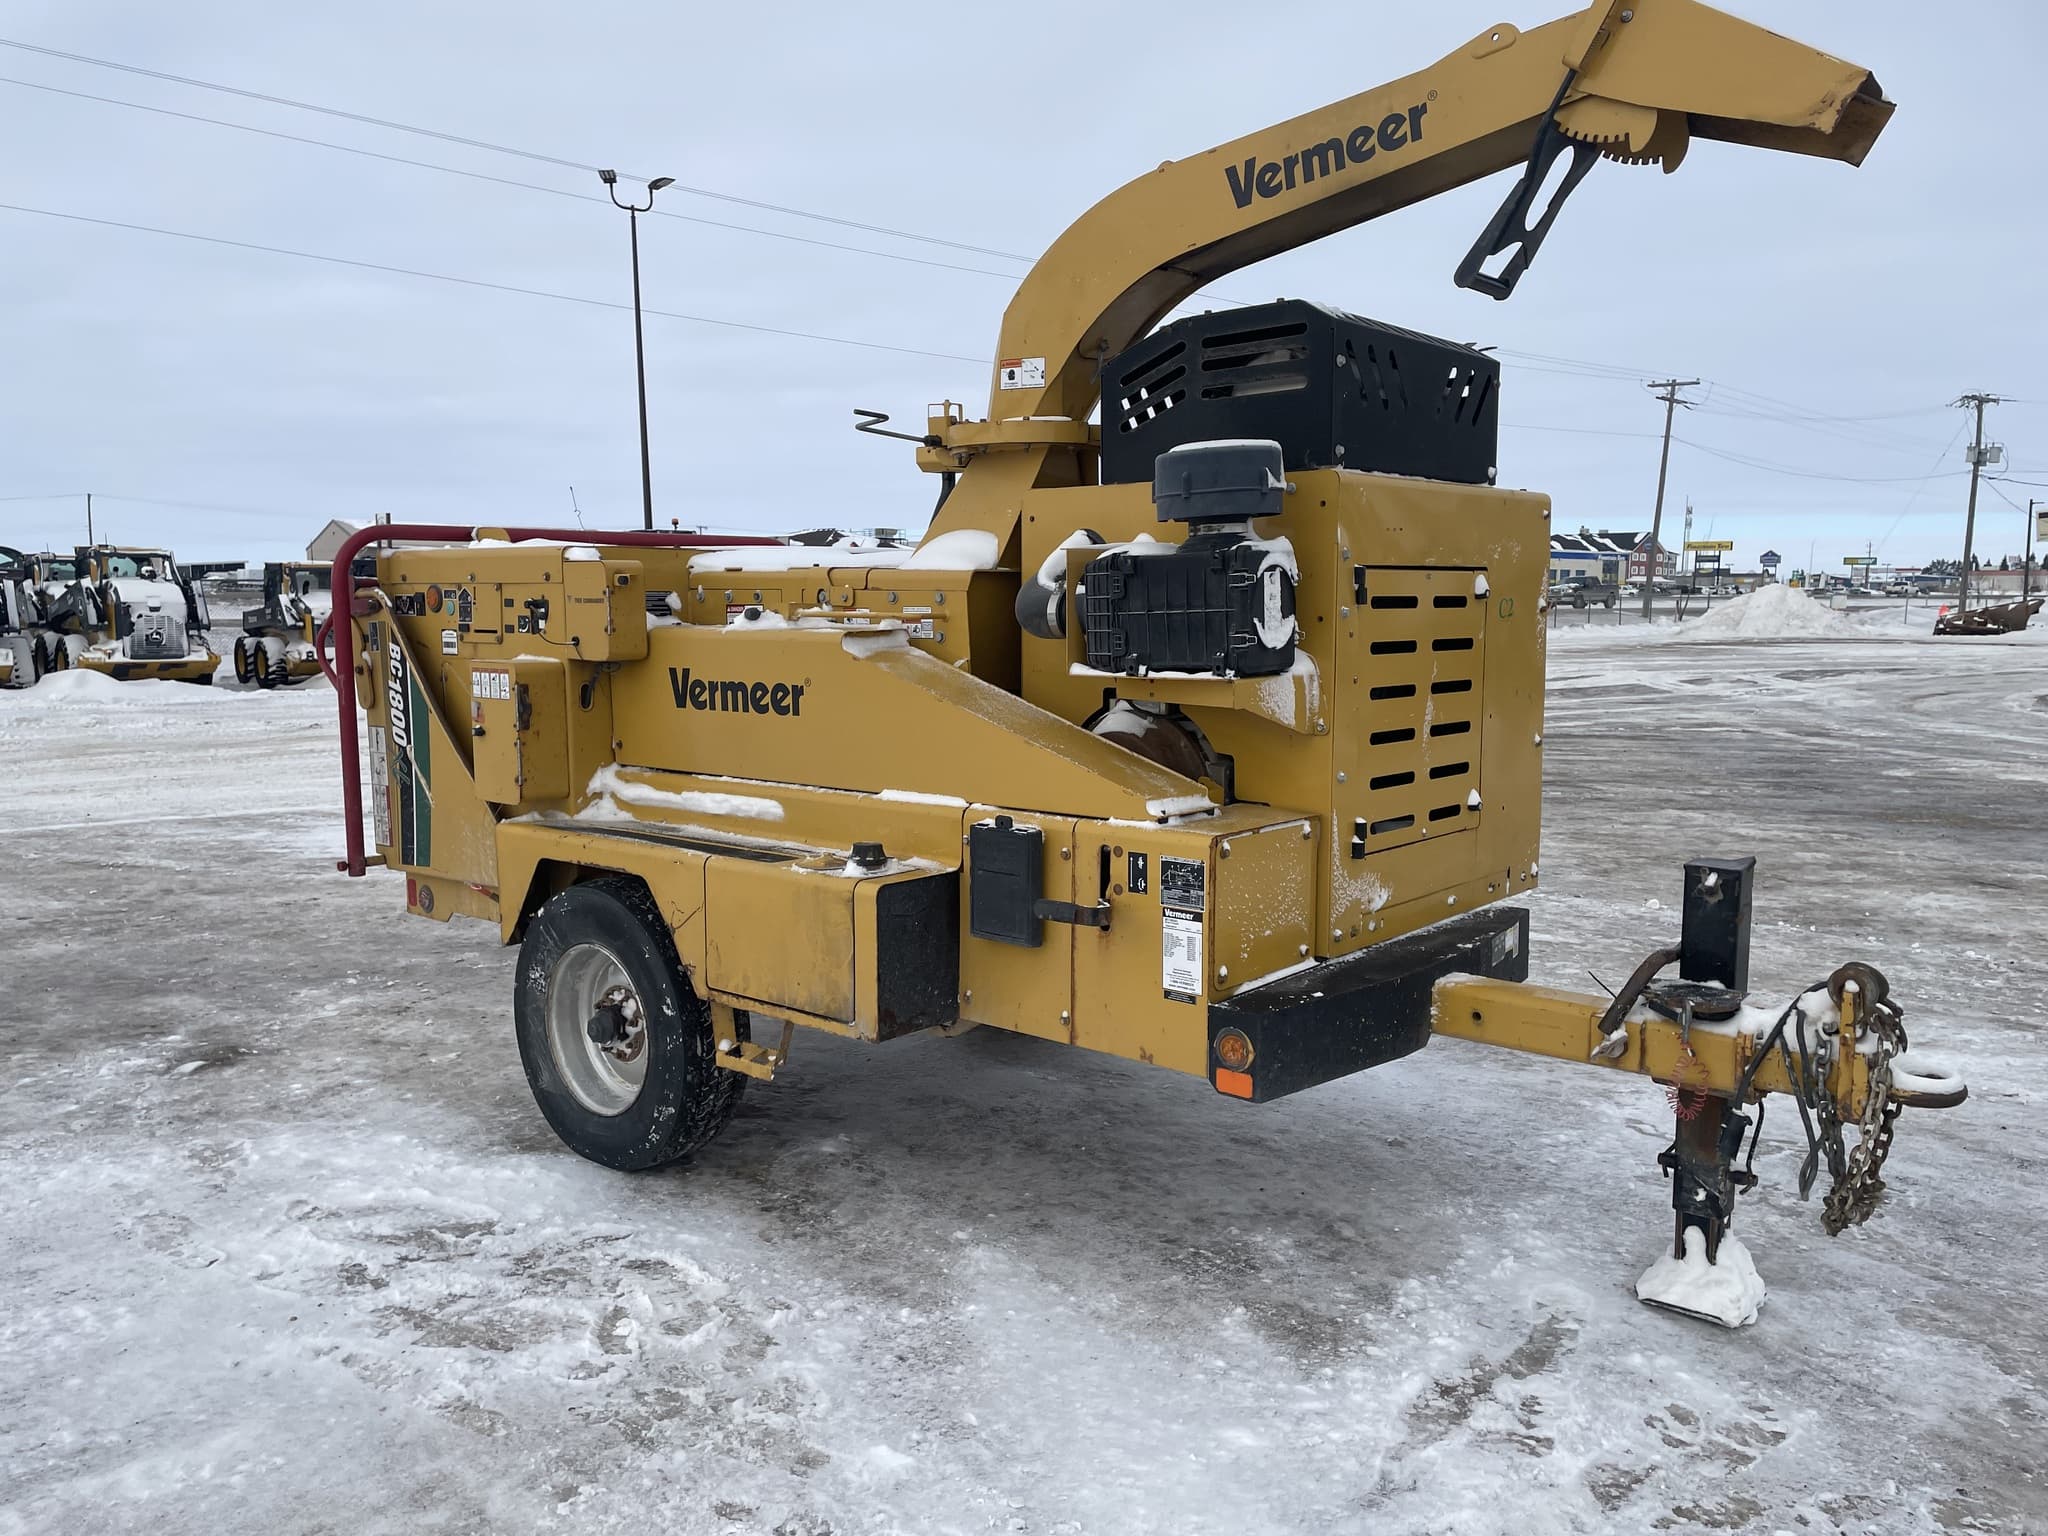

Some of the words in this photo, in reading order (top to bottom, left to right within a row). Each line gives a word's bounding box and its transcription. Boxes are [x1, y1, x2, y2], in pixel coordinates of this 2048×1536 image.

[1225, 102, 1428, 209] Vermeer
[668, 667, 806, 717] Vermeer
[1164, 908, 1194, 920] Vermeer
